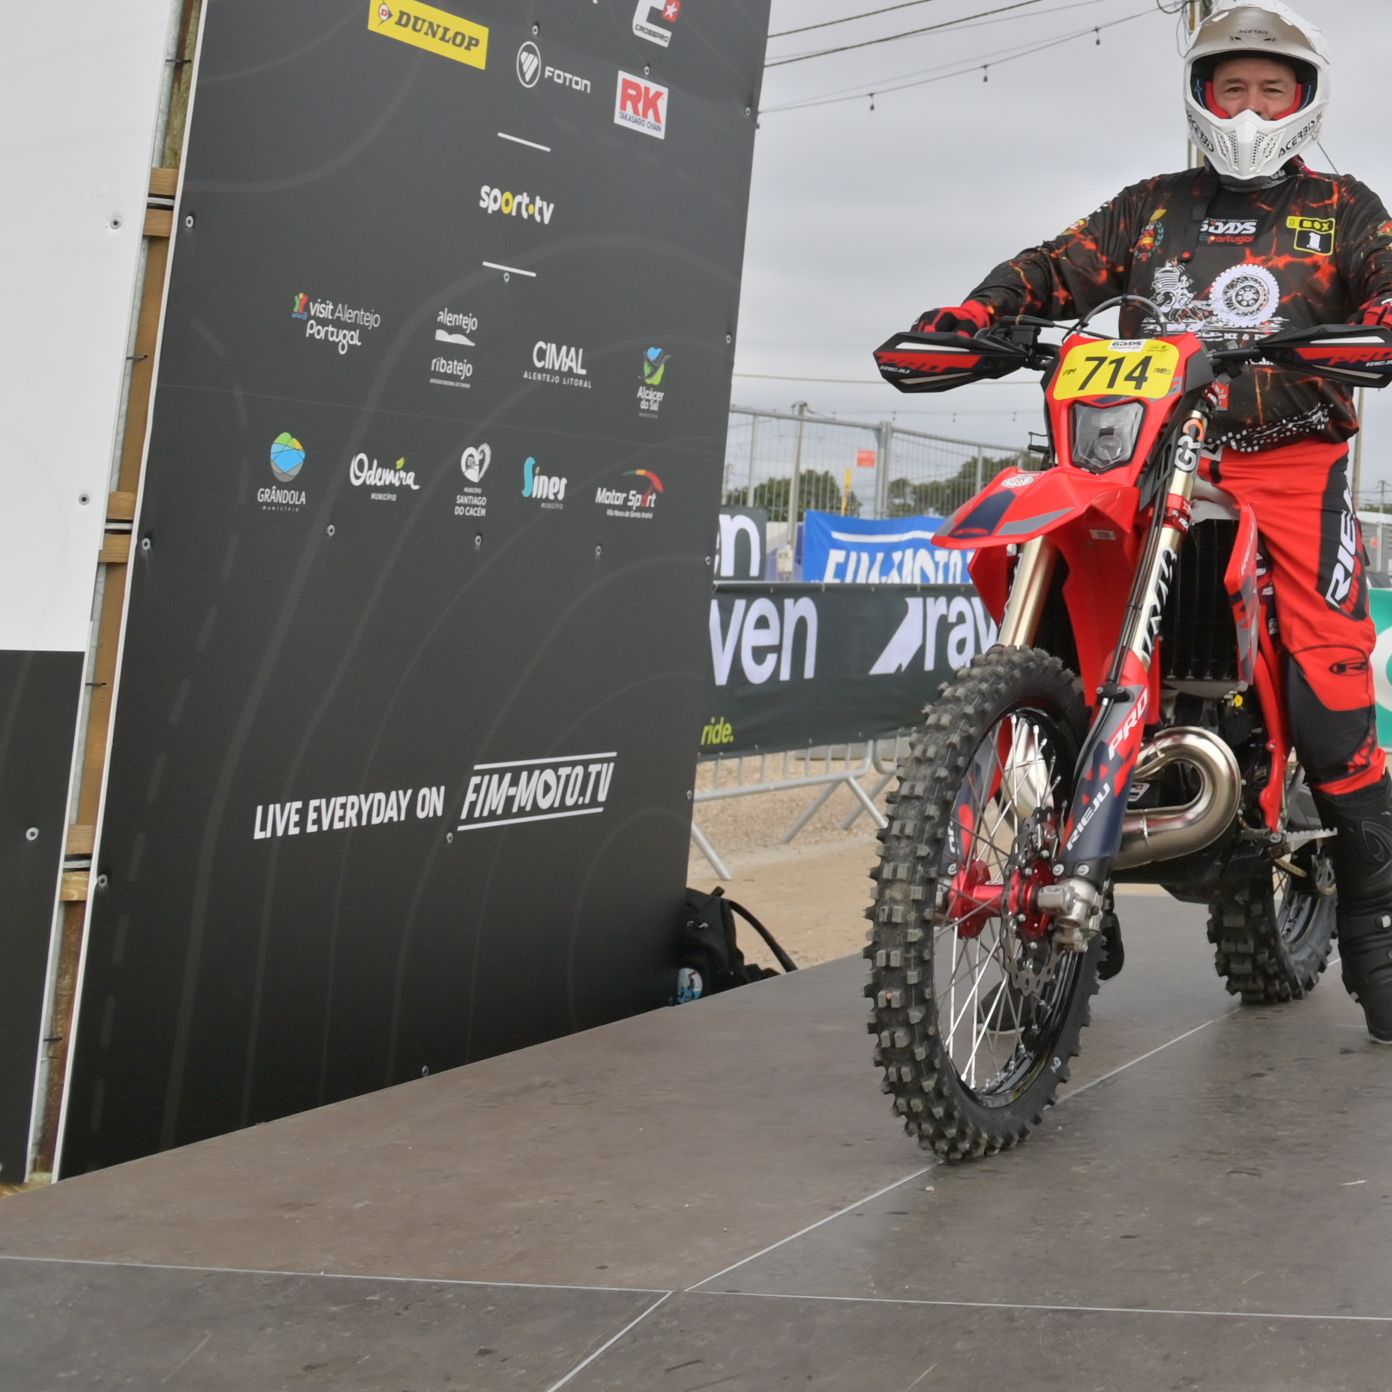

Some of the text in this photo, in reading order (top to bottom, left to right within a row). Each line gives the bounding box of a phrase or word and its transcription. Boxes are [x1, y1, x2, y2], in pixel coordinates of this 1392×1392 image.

[399, 10, 480, 52] DUNLOP
[545, 66, 591, 94] FOTON
[620, 79, 664, 123] RK
[309, 299, 381, 330] visit Alentejo
[437, 308, 478, 334] alentejo
[306, 320, 362, 355] Portugal
[431, 357, 473, 380] ribatejo
[533, 341, 587, 375] CIMAL
[1078, 356, 1153, 391] 714
[523, 371, 592, 389] ALENTEJO LITORAL
[350, 453, 421, 490] Odemira
[522, 457, 567, 501] Sines
[257, 485, 306, 505] GRÂNDOLA
[456, 495, 487, 506] SANTIAGO
[595, 487, 656, 510] Motor Sport
[709, 596, 818, 686] ven
[1108, 686, 1149, 761] PRO
[253, 762, 615, 840] LIVE EVERYDAY ON FIM-MOTO.TV
[1066, 782, 1111, 851] RIEJU
